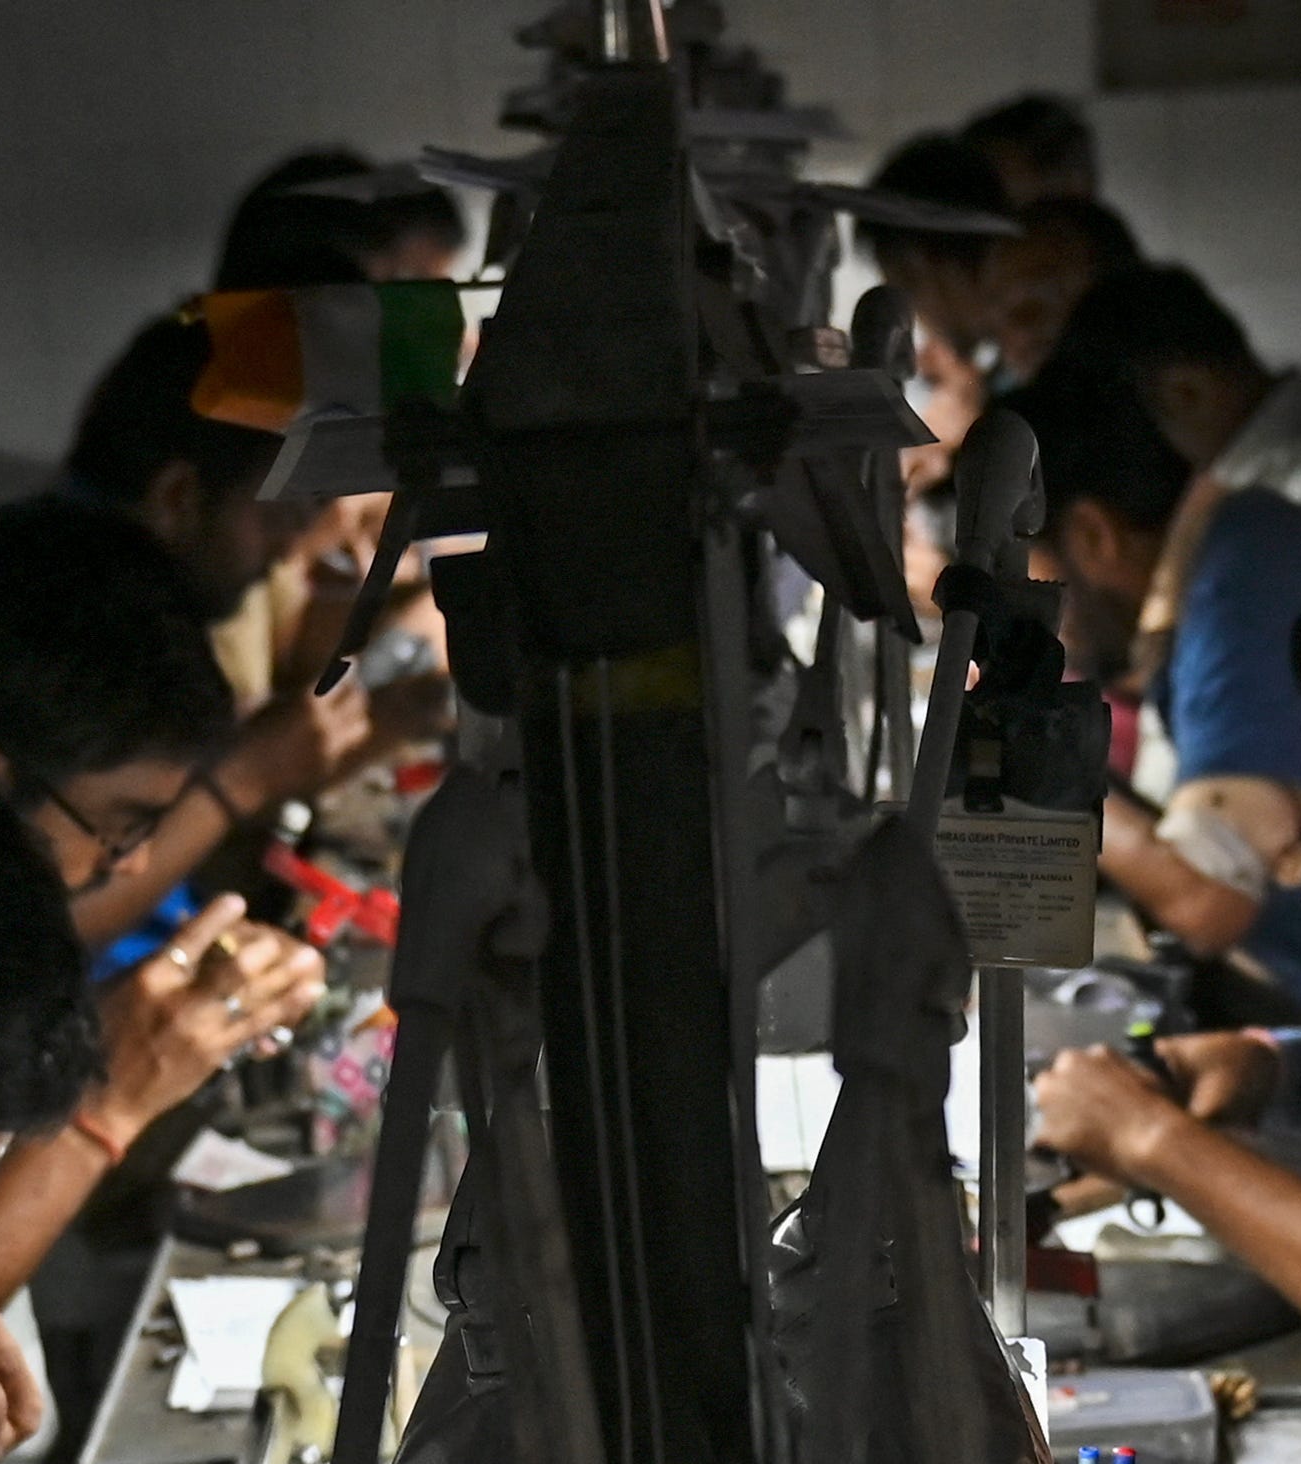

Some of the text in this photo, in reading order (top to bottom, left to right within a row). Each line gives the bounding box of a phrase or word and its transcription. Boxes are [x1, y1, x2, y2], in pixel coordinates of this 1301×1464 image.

[936, 832, 966, 843] HIRAG
[998, 832, 1039, 846] PRIVATE
[1040, 835, 1080, 848] LIMITED
